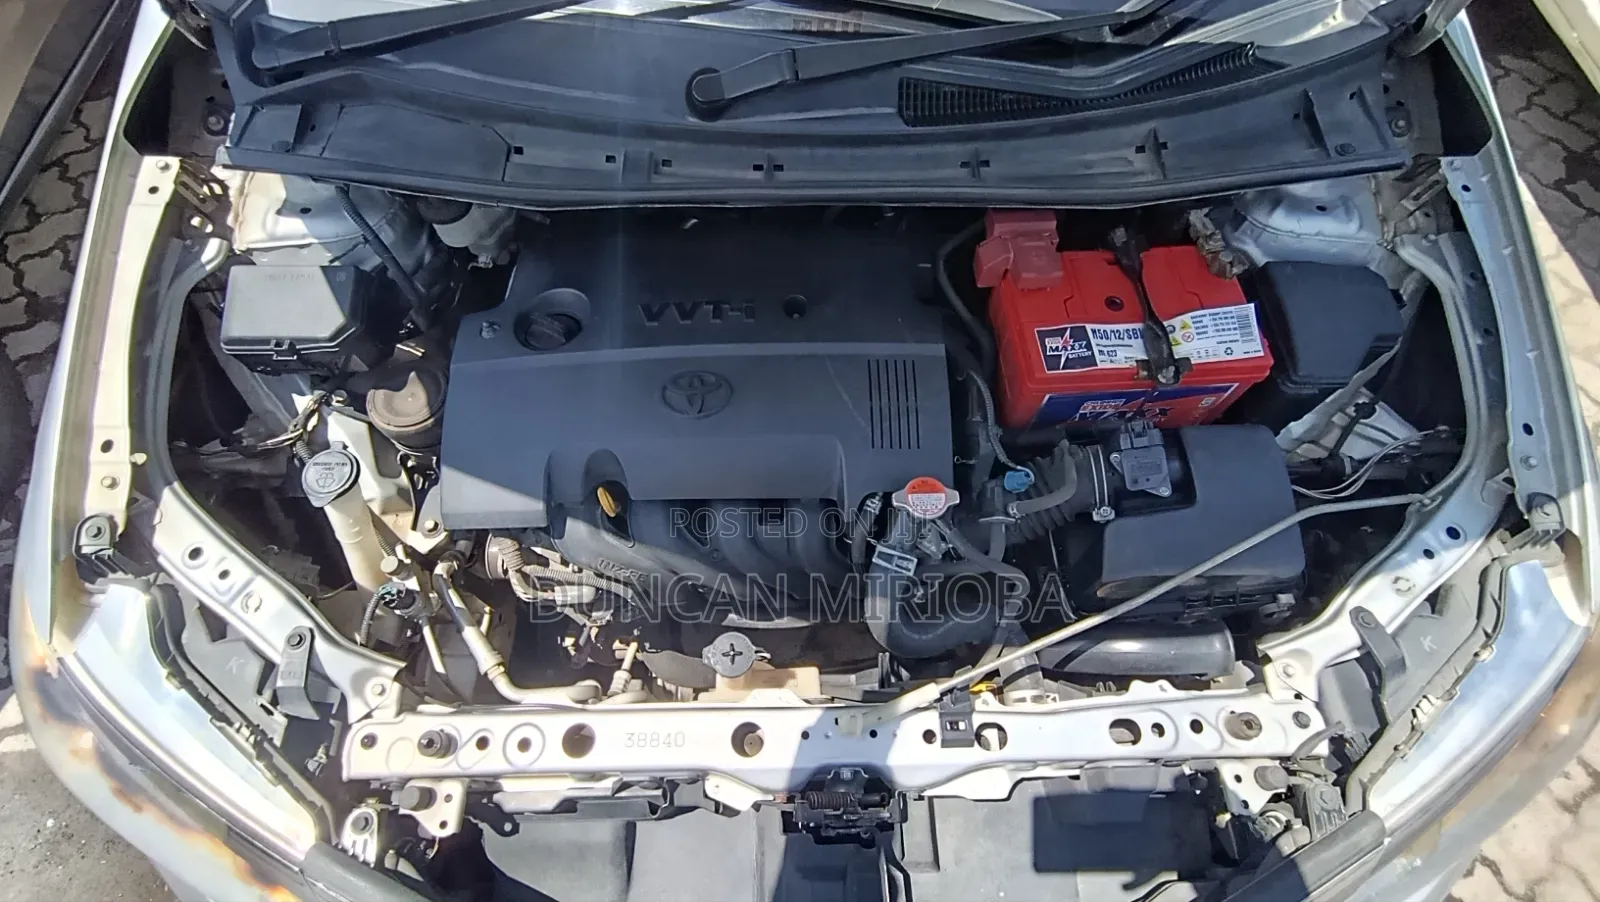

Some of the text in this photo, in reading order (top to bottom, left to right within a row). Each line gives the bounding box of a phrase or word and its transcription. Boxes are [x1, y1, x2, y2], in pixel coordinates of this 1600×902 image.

[638, 301, 755, 326] VVT-i
[1067, 350, 1093, 360] BATTERY
[624, 730, 686, 749] 38840
